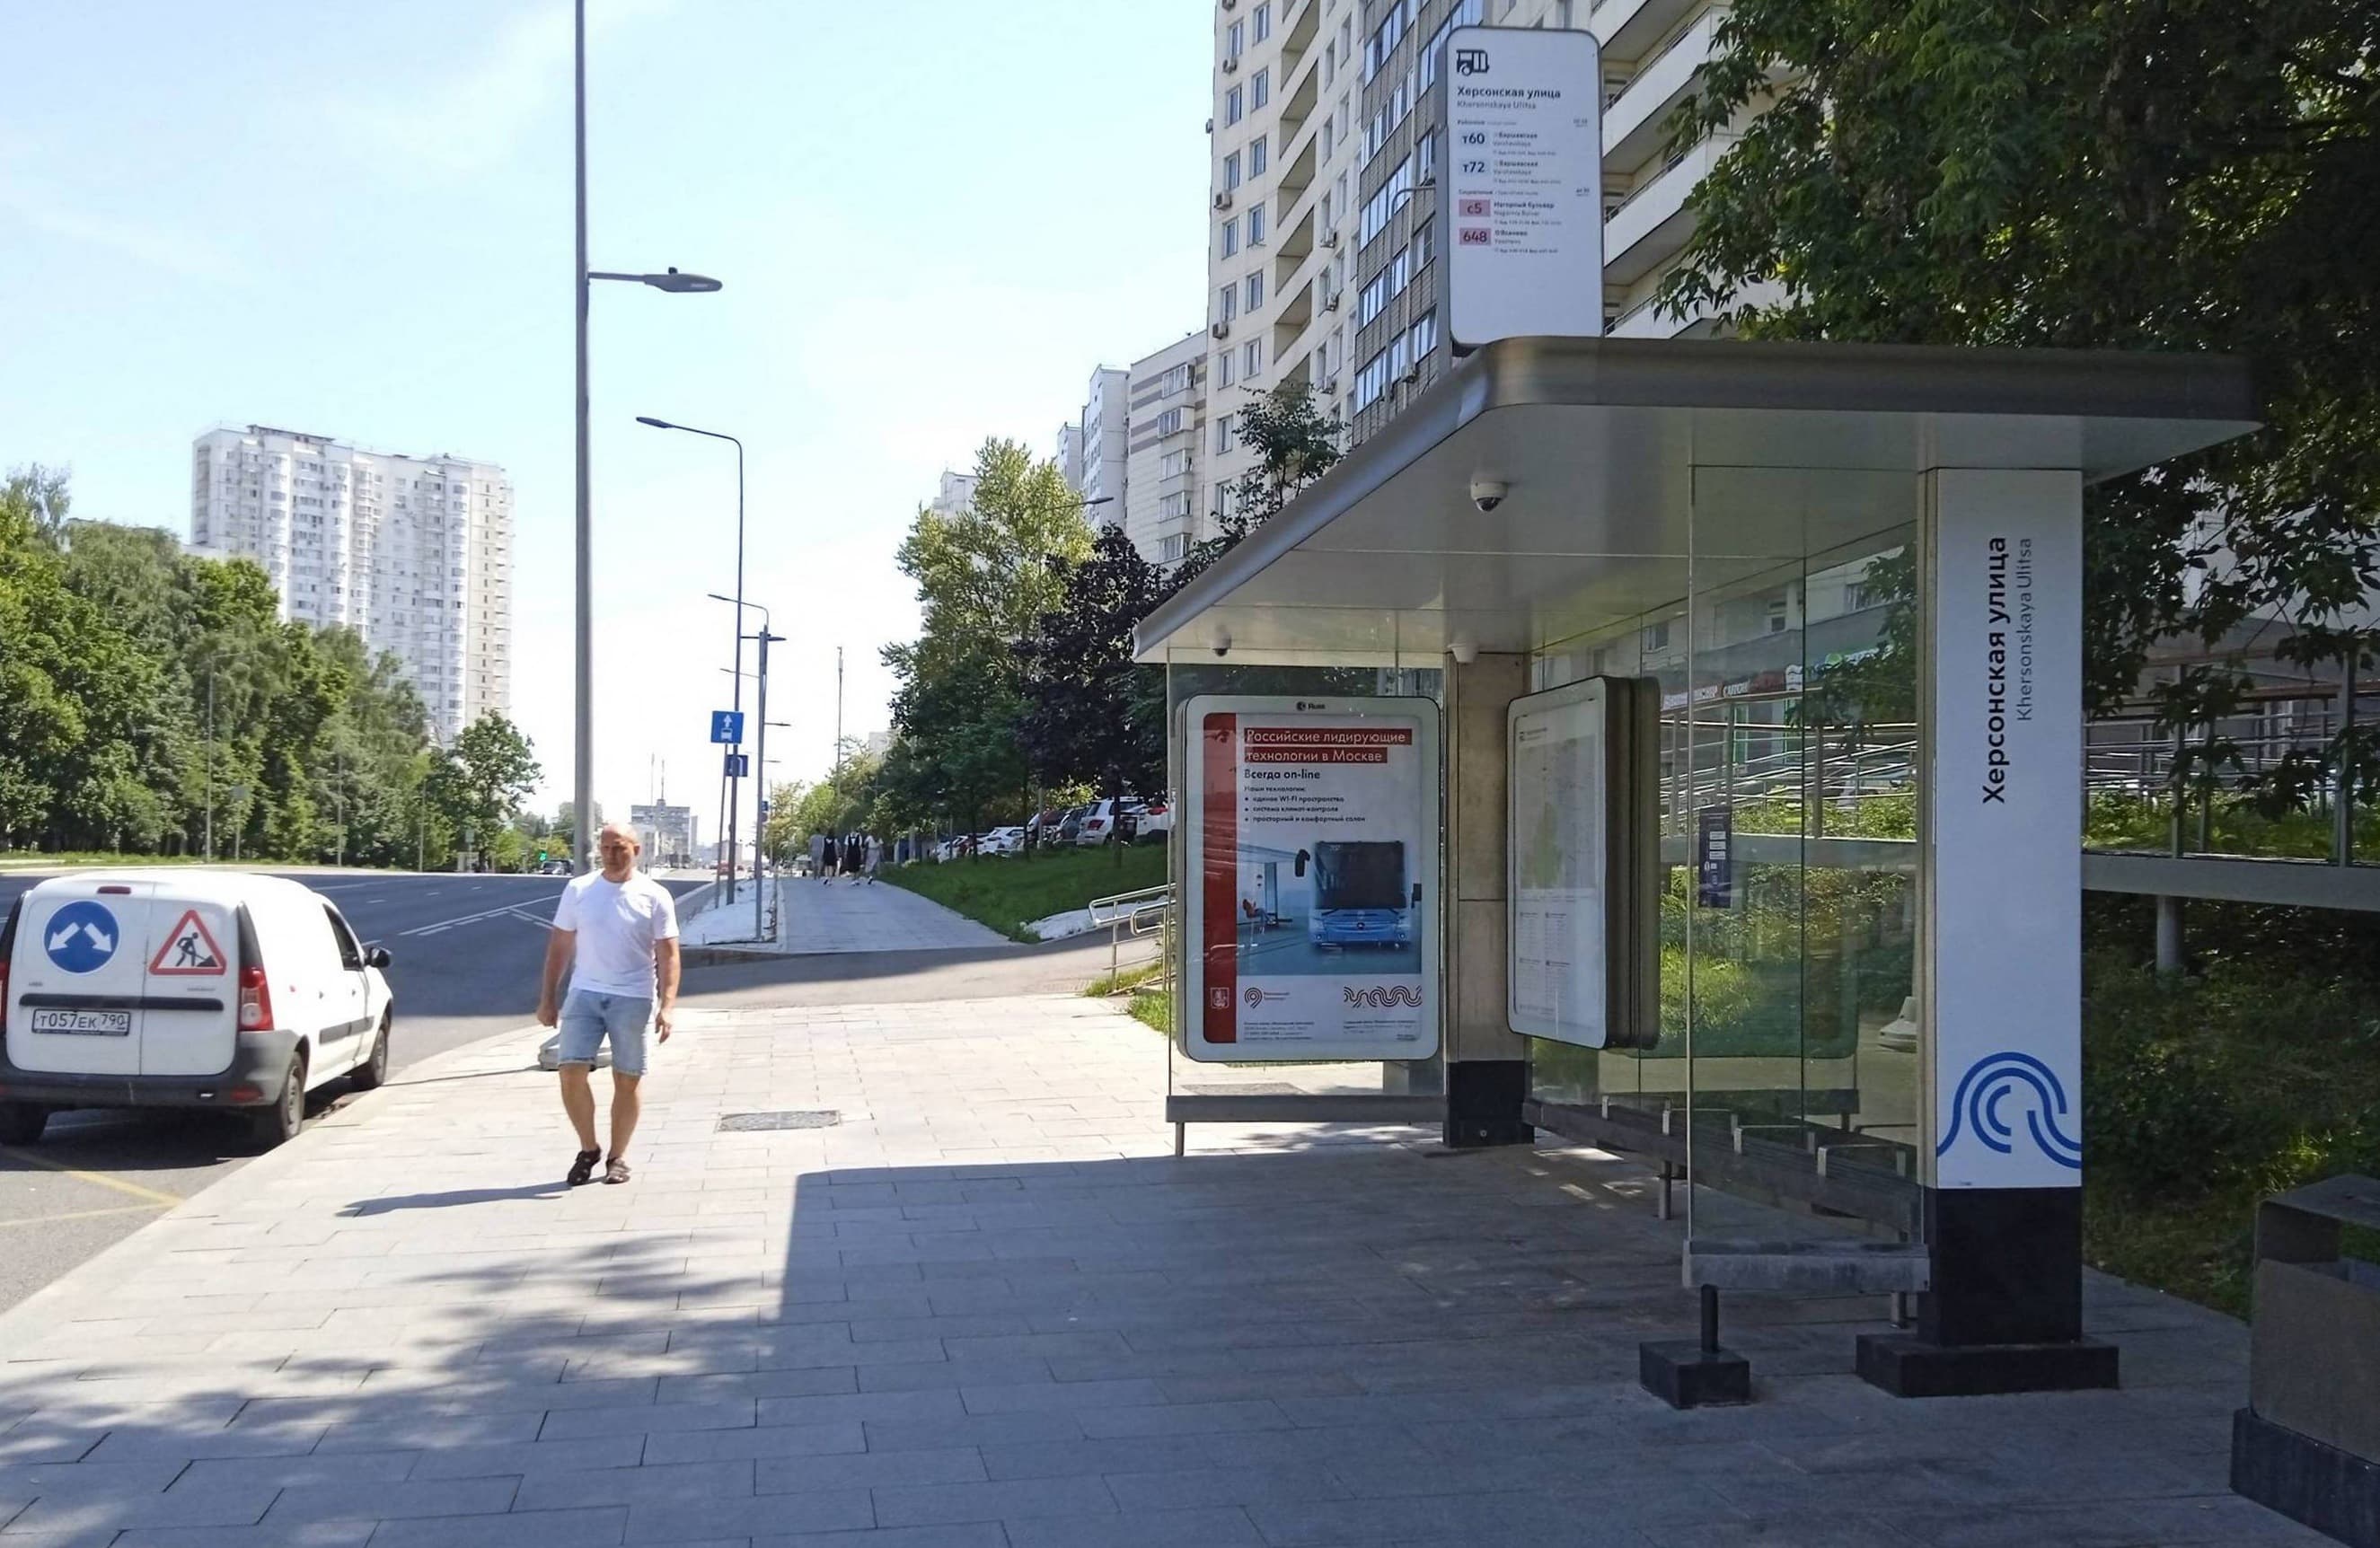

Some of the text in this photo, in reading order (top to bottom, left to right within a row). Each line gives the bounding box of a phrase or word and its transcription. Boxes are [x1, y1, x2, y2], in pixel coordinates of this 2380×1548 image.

[1457, 86, 1561, 100] Херсонская улица
[1462, 133, 1485, 145] т60
[1462, 162, 1485, 173] т72
[1463, 231, 1487, 242] 648
[2016, 538, 2035, 721] Khersonskaya Ulitsa
[1982, 537, 2011, 804] Херсонская улица
[1247, 729, 1406, 745] Российские лидирующие
[1247, 749, 1382, 762] технологии в Москве
[1244, 768, 1321, 780] Всегда on-line
[1300, 815, 1344, 823] комфортный
